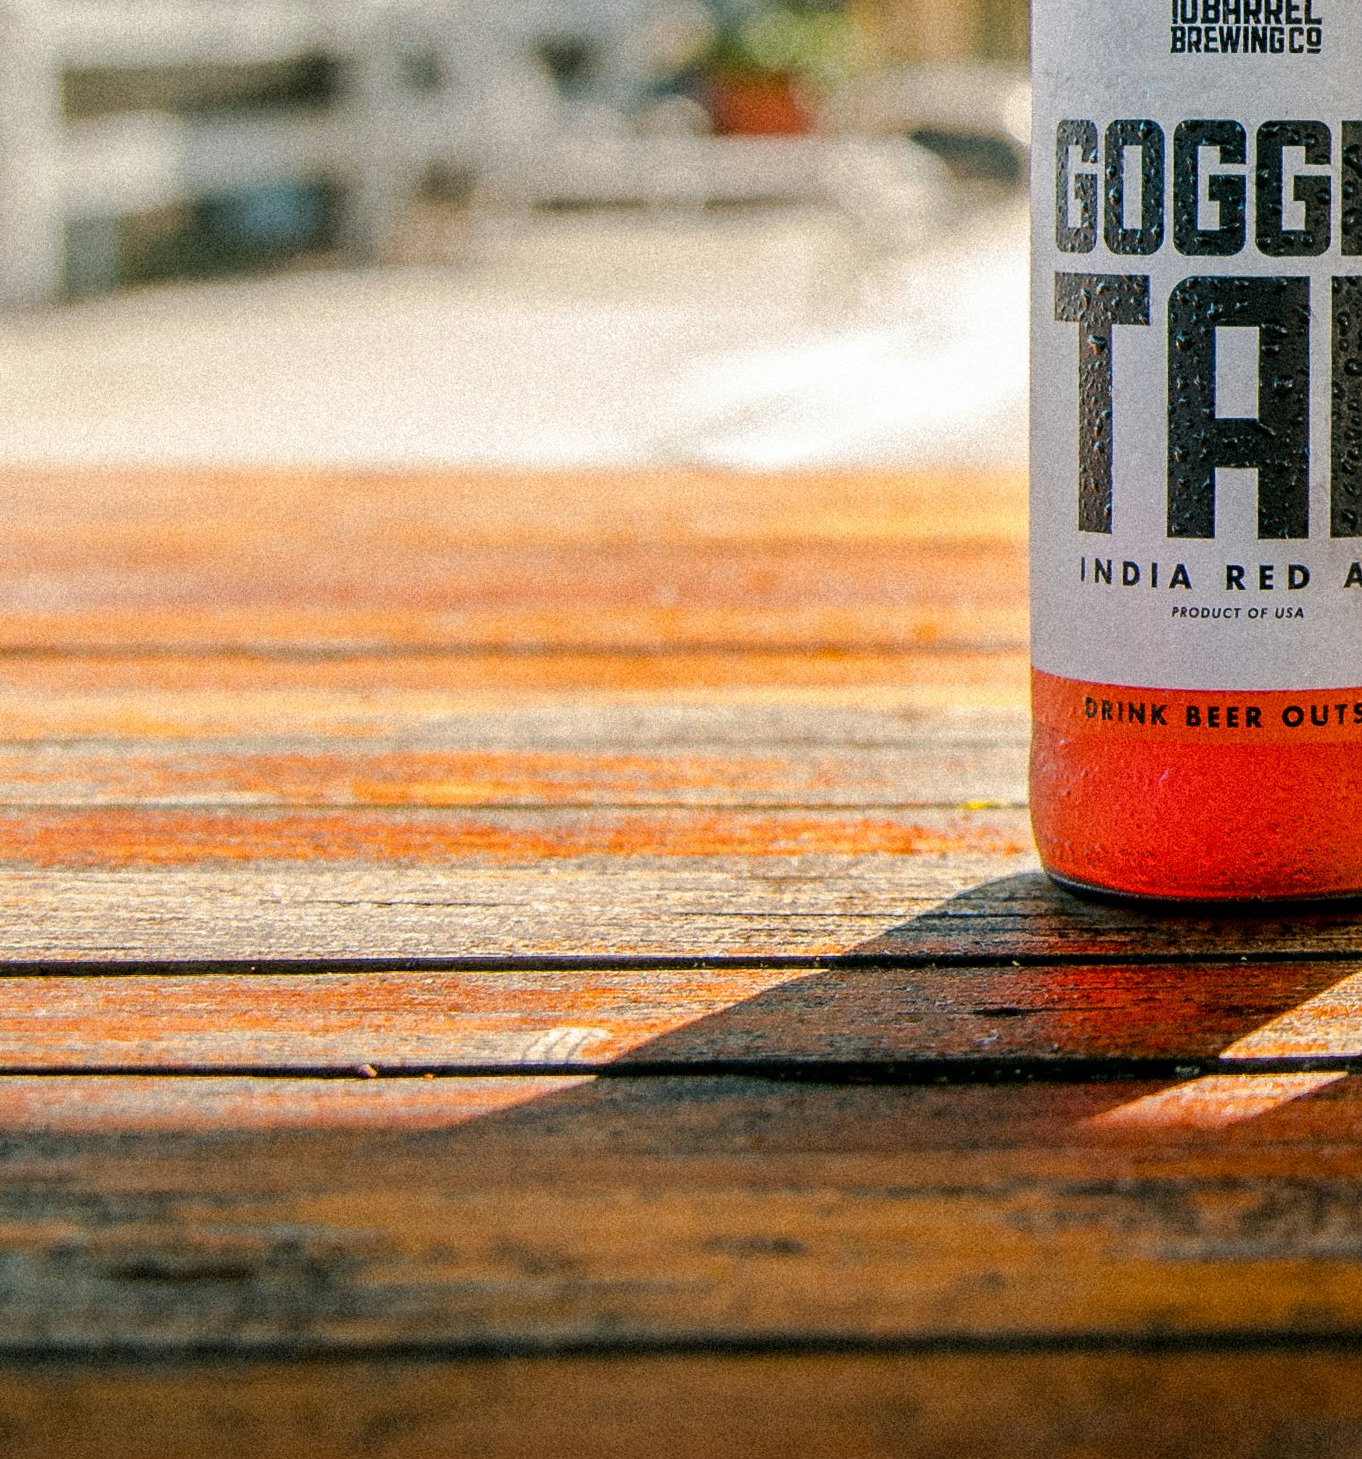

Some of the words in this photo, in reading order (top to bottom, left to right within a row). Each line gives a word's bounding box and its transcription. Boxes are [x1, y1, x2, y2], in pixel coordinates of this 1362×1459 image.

[1079, 557, 1193, 590] INDIA
[1225, 564, 1311, 591] RED
[1171, 606, 1242, 619] PRODUCT
[1247, 607, 1267, 619] OF
[1274, 607, 1305, 619] USA
[1084, 696, 1168, 726] DRINK
[1185, 705, 1262, 728] BEER
